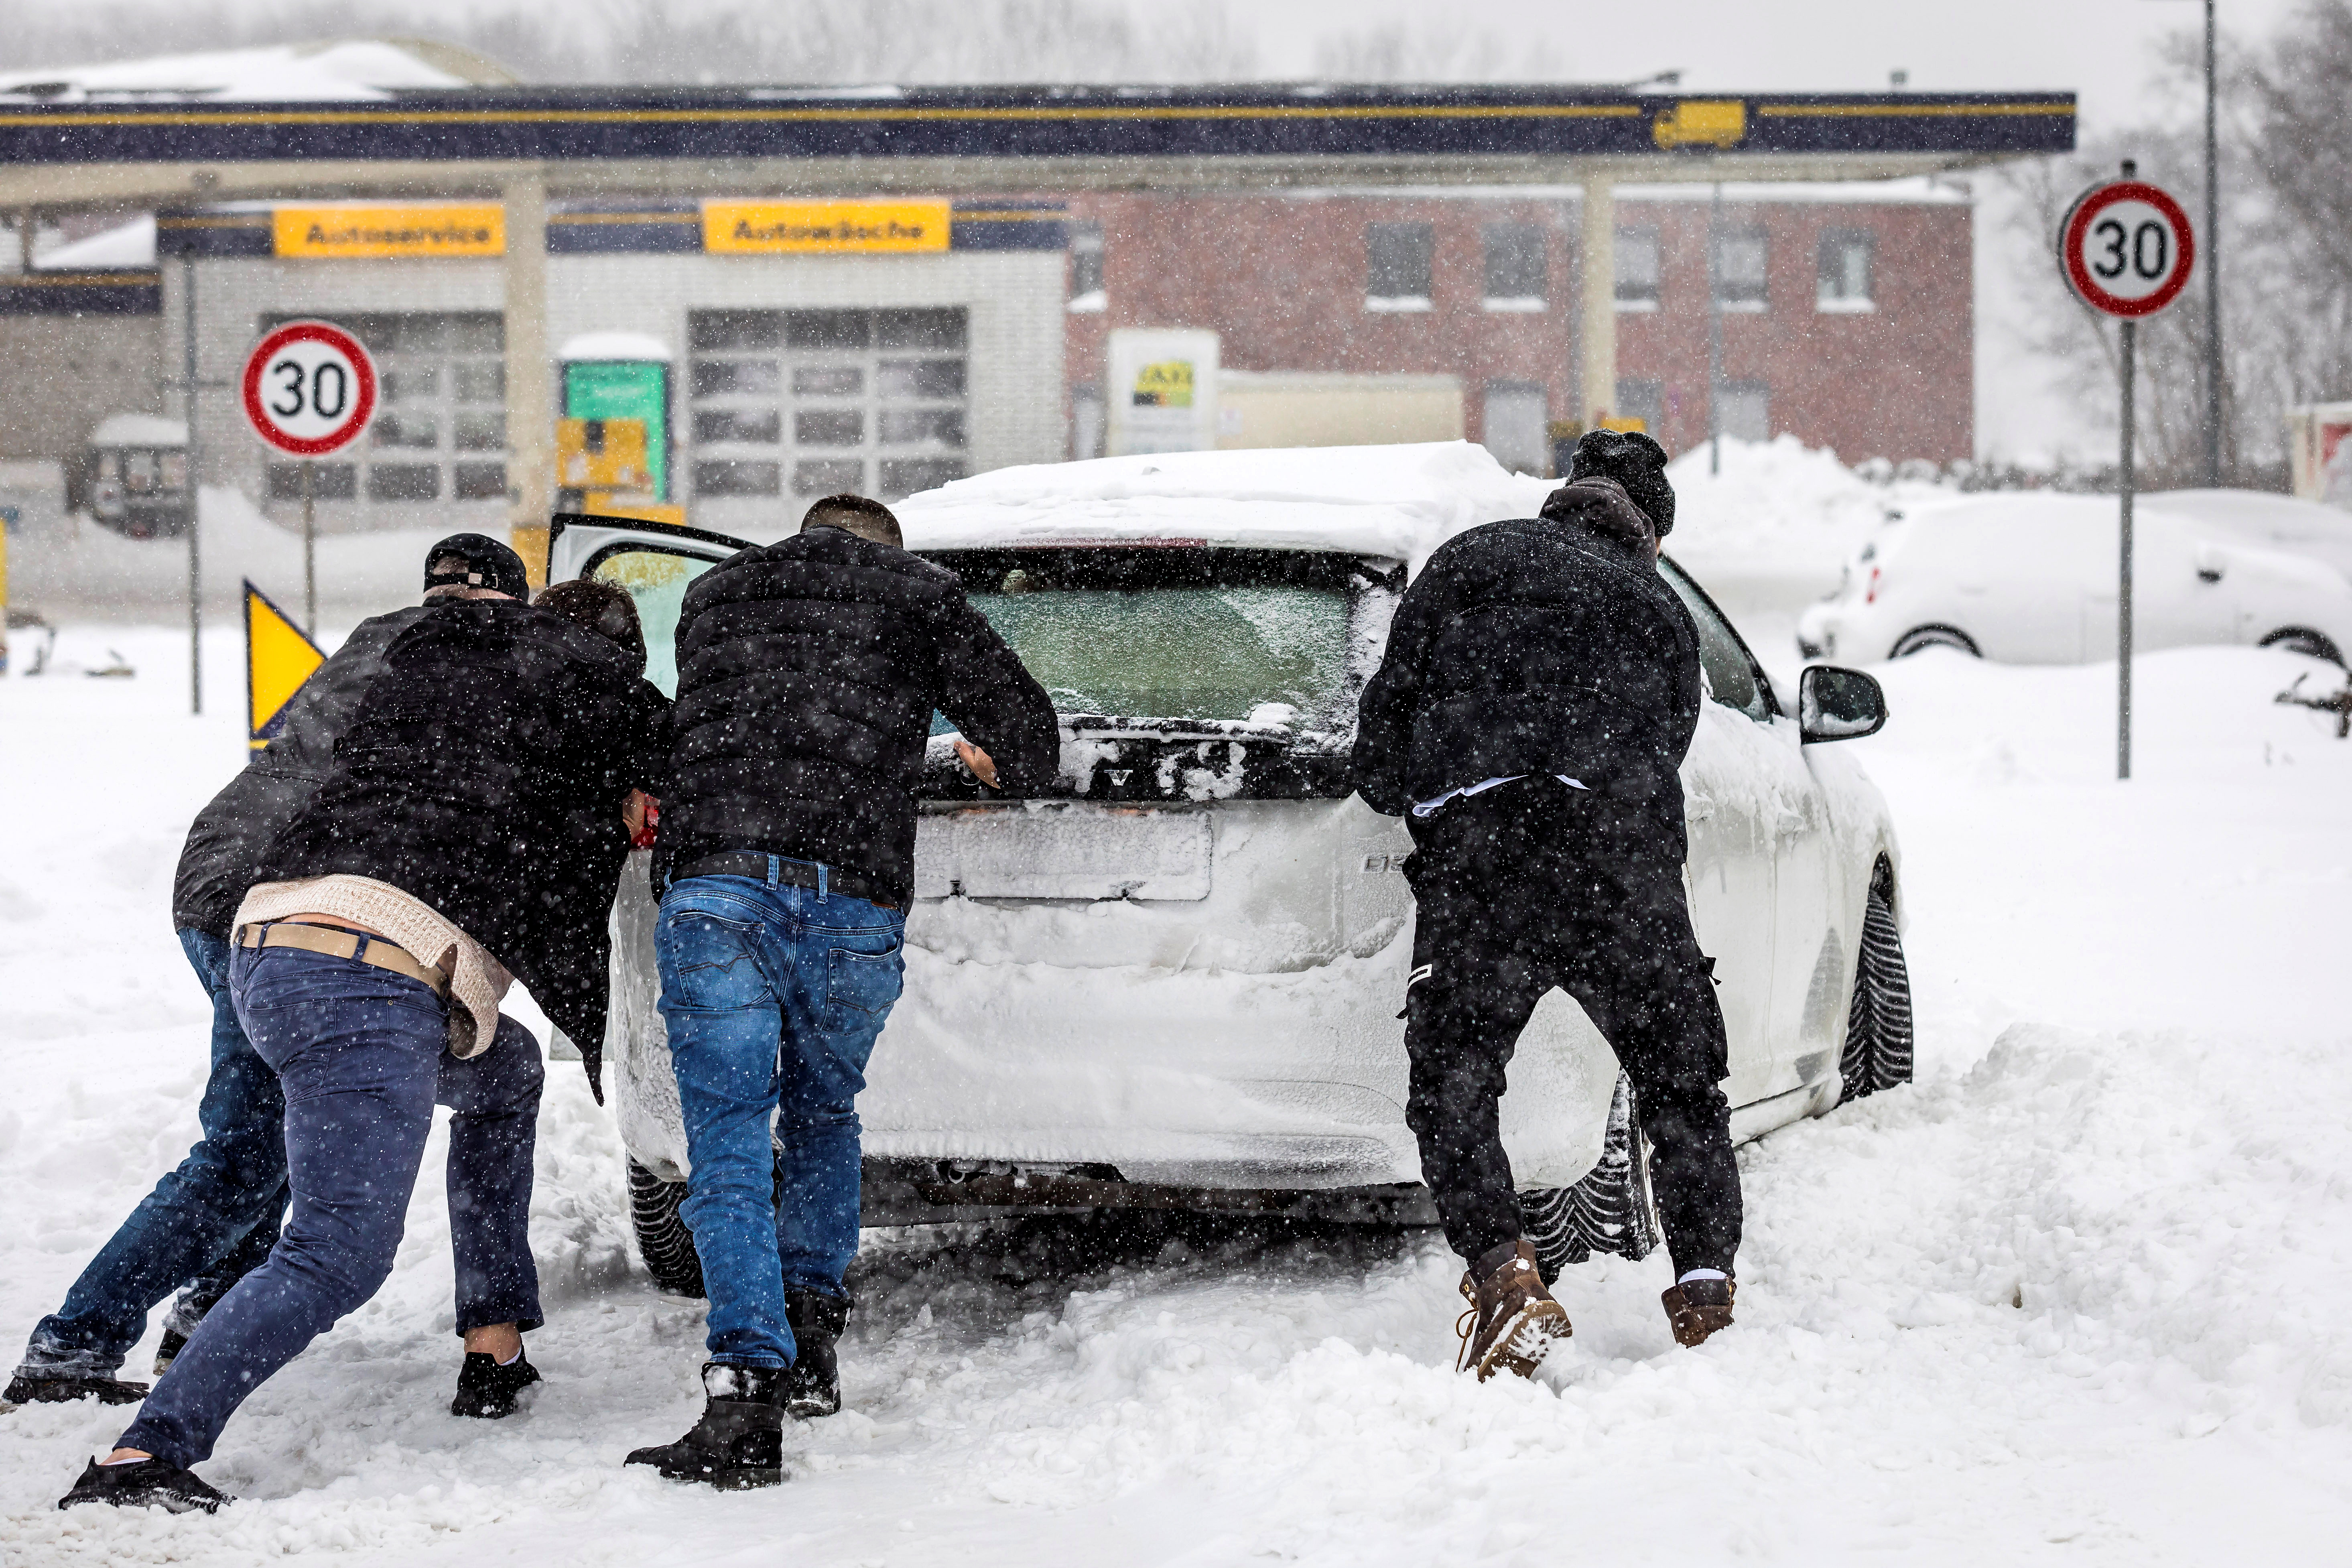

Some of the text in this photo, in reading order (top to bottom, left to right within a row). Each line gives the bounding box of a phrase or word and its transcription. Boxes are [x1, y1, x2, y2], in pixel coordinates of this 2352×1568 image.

[305, 221, 491, 244] Autoservice
[733, 219, 924, 240] Autowäsche
[2094, 219, 2167, 280] 30
[272, 360, 347, 418] 30
